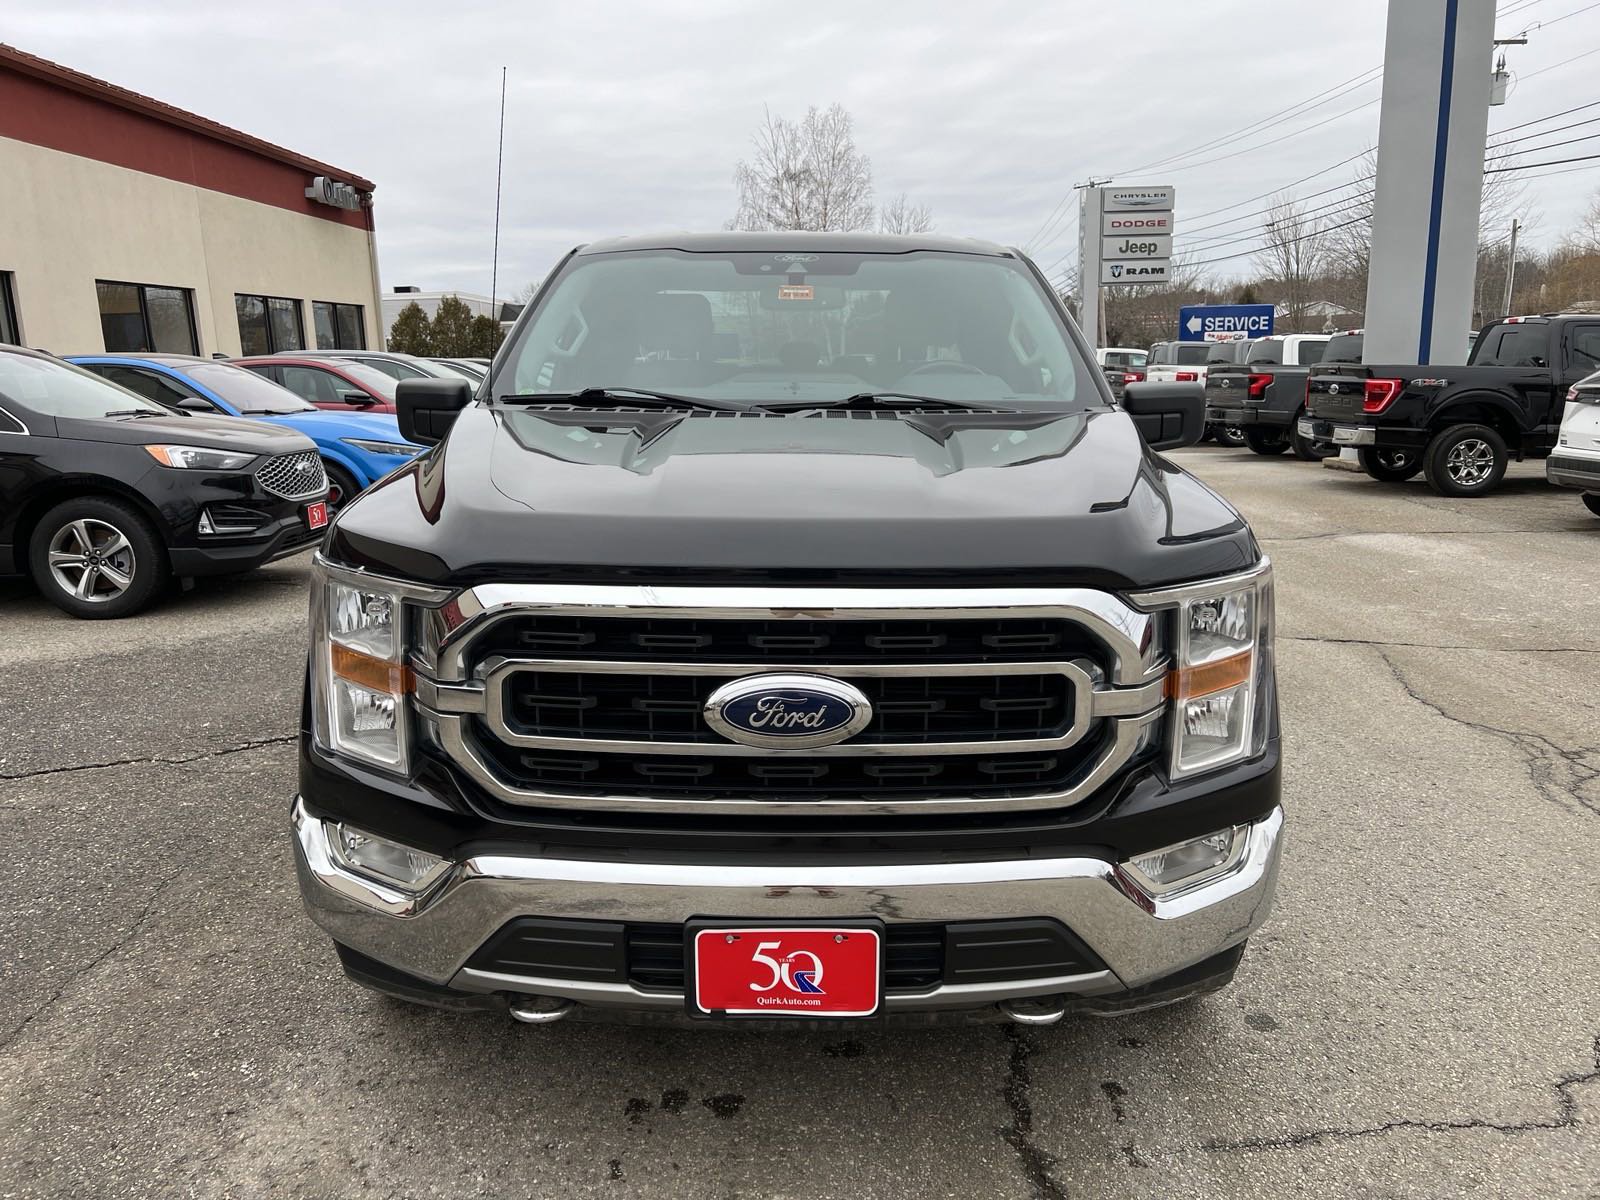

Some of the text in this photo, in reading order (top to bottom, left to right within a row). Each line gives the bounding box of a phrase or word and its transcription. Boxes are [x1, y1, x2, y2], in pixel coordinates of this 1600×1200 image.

[1111, 219, 1167, 228] DODGE
[1119, 240, 1158, 256] Jeep
[1126, 267, 1165, 275] RAM
[1204, 316, 1270, 331] SERVICE
[749, 696, 828, 728] Ford
[757, 997, 821, 1005] QuirkAuto.com
